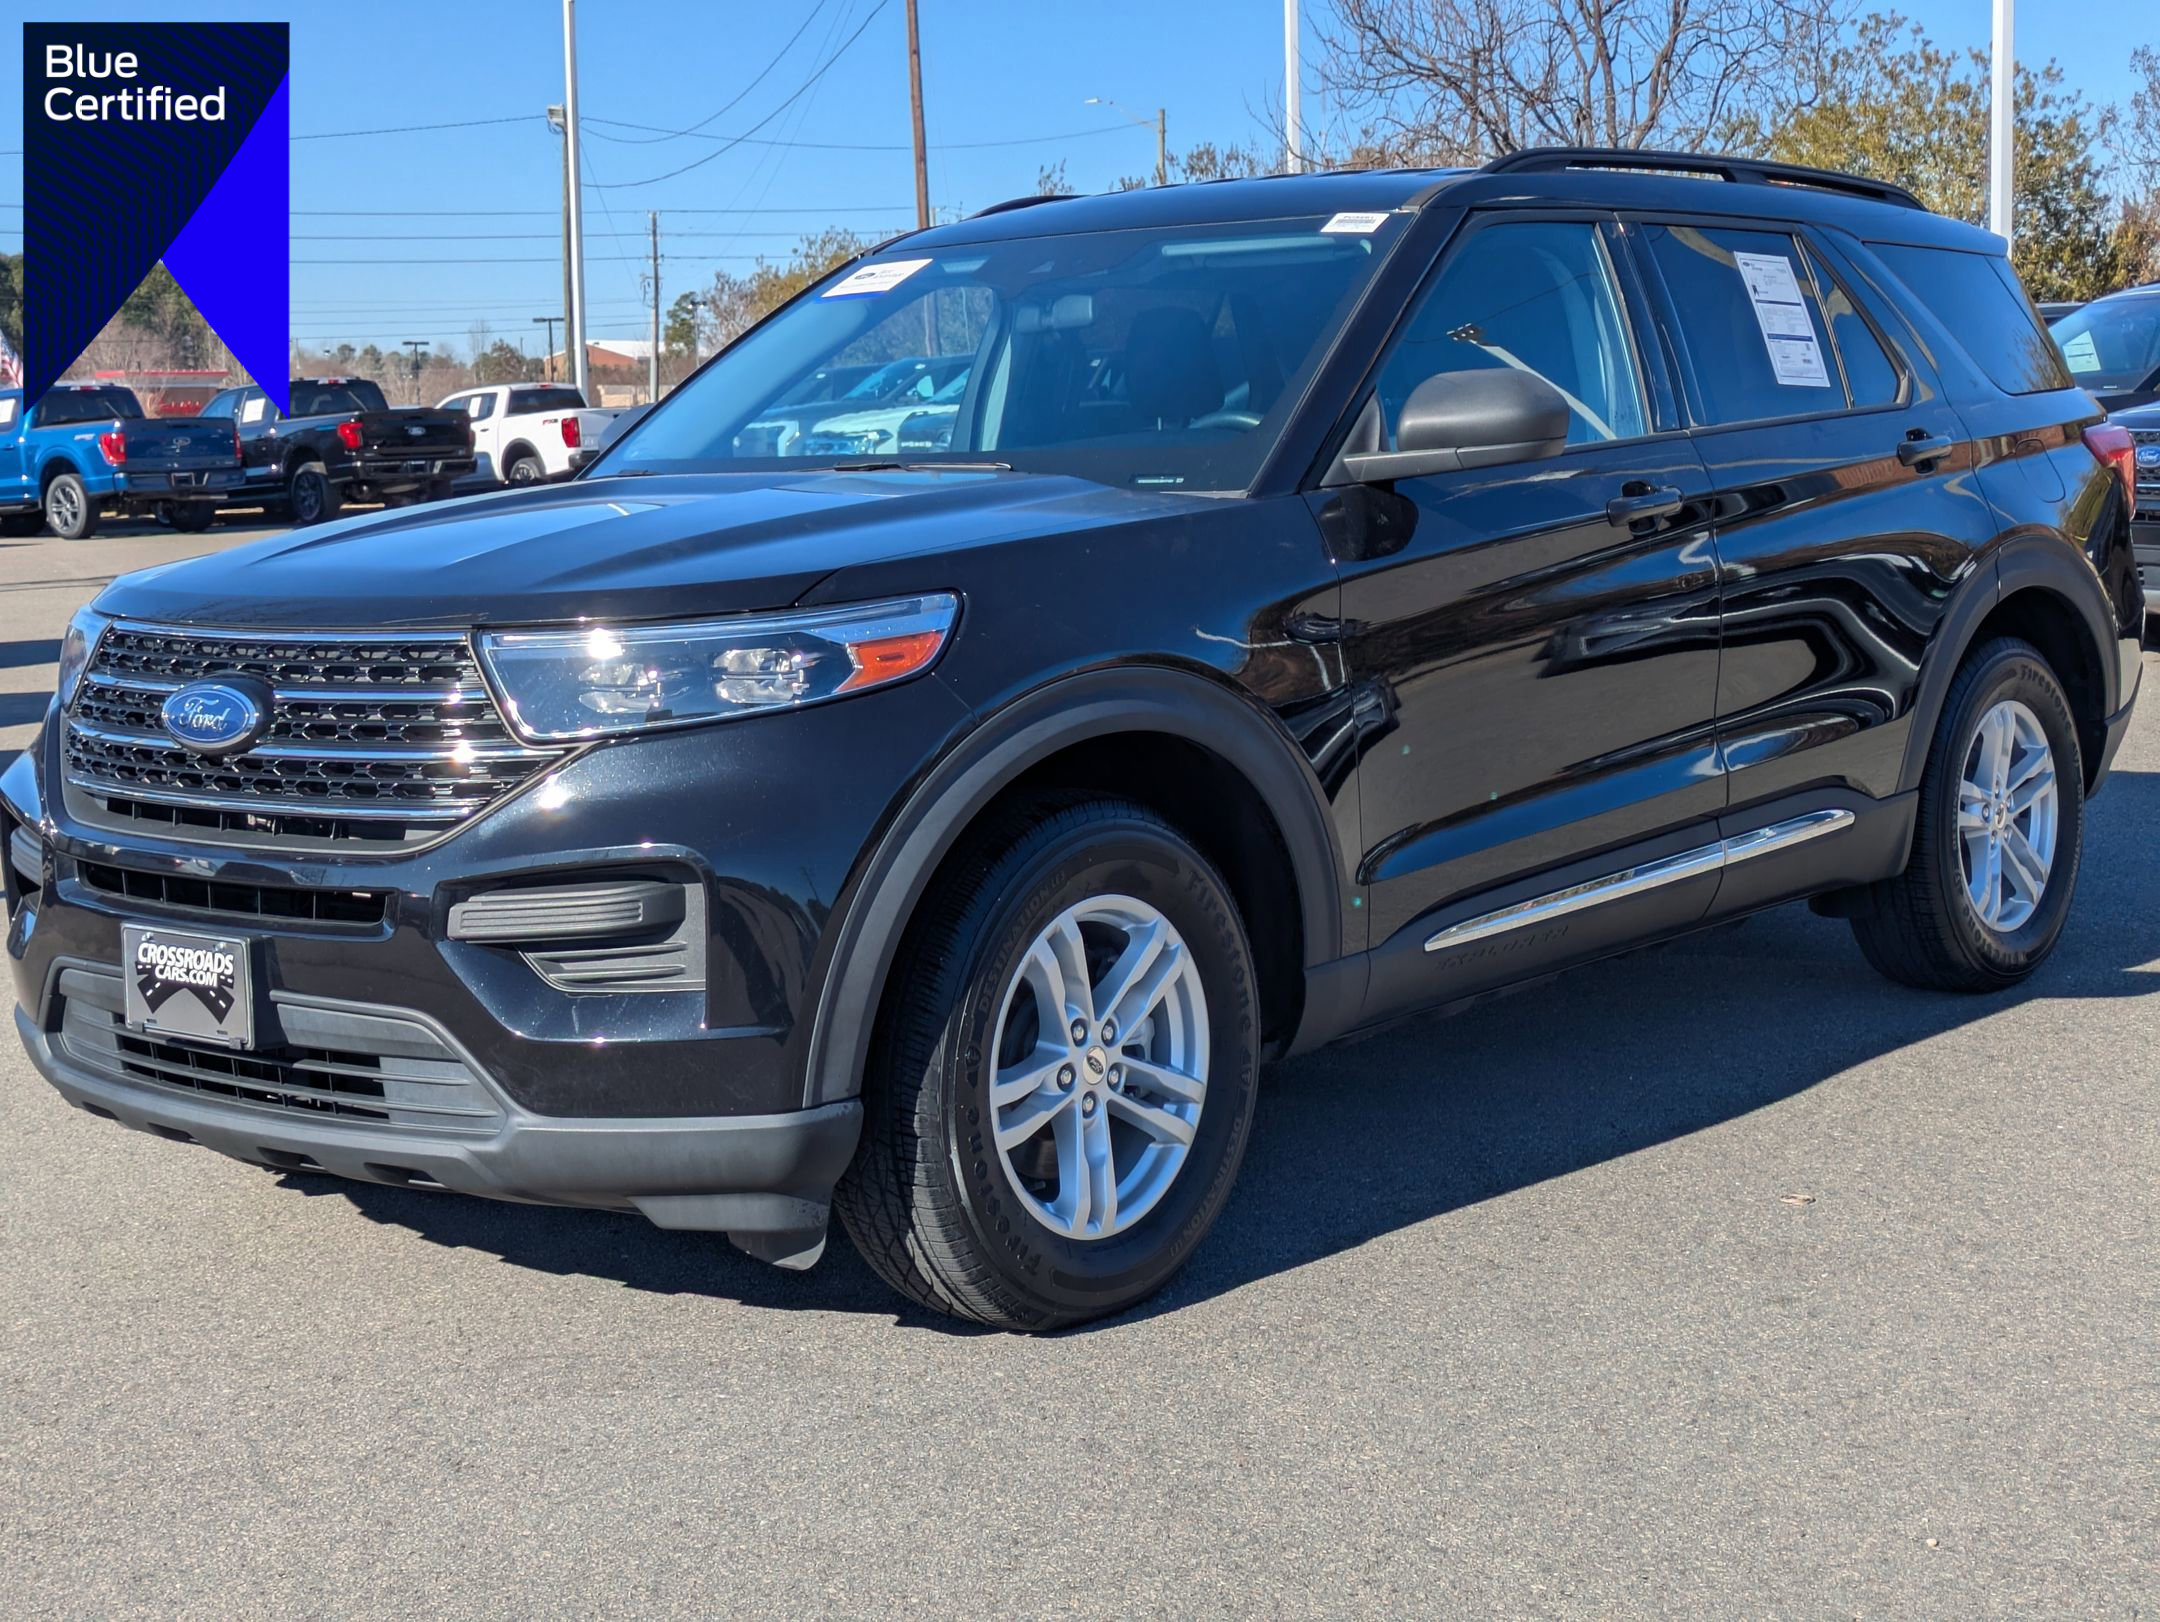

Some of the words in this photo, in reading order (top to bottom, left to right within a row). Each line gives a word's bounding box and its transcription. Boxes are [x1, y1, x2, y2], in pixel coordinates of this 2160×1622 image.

[179, 696, 231, 733] Ford
[138, 943, 234, 975] CROSSROADS
[155, 965, 218, 987] CARS.COM
